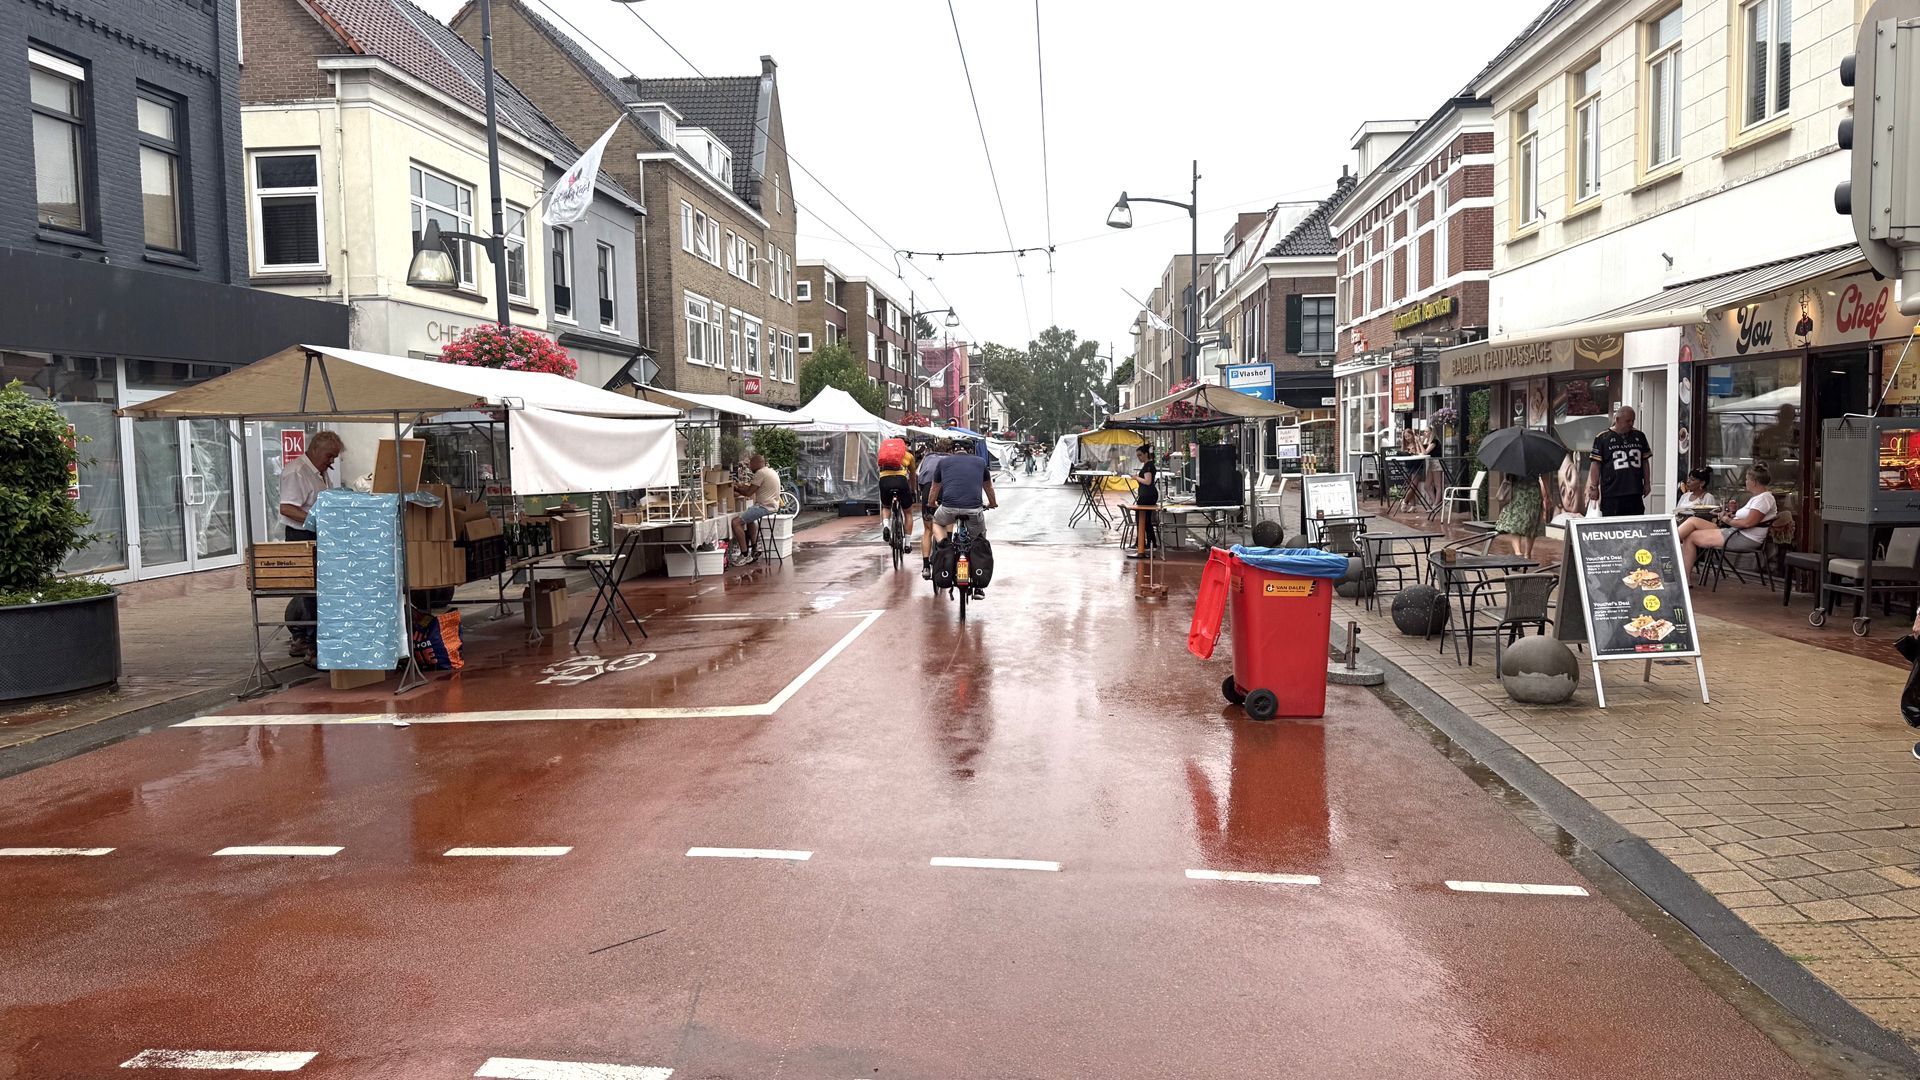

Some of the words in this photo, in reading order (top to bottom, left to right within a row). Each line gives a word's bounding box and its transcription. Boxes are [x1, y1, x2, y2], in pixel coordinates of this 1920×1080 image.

[1736, 305, 1773, 354] You
[1836, 283, 1889, 339] Chef
[1483, 348, 1503, 371] THAI
[1504, 342, 1553, 367] MASSAGE
[1239, 370, 1266, 378] Vlashof
[746, 381, 759, 393] illy
[284, 436, 302, 452] DK
[1612, 449, 1641, 470] 23
[1582, 529, 1647, 541] MENUDEAL
